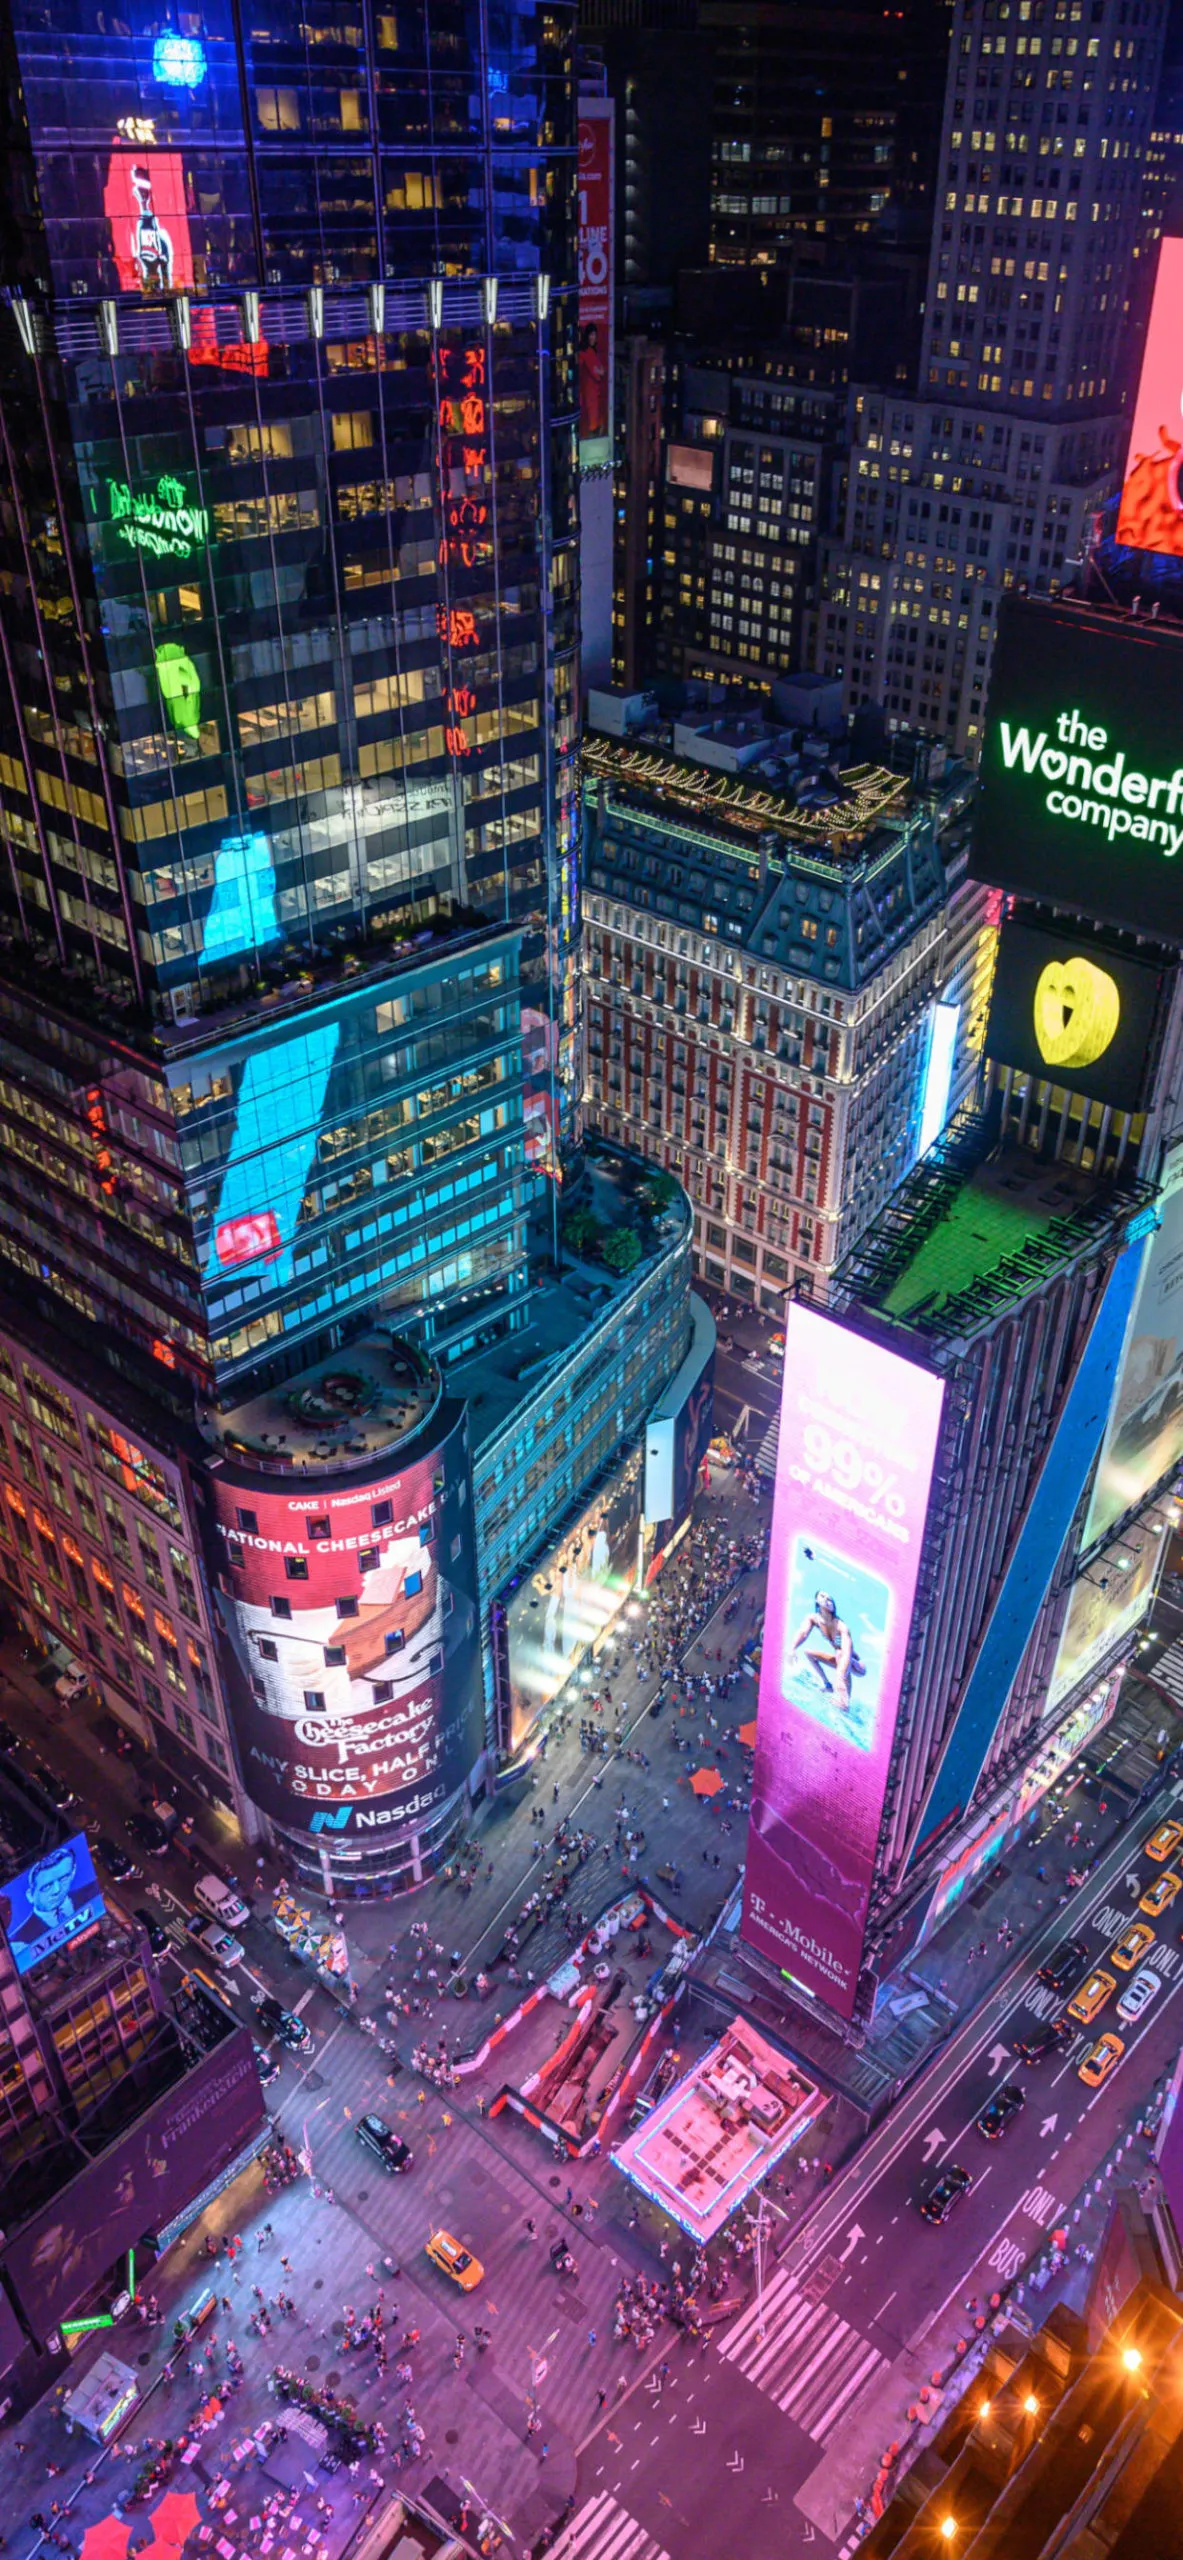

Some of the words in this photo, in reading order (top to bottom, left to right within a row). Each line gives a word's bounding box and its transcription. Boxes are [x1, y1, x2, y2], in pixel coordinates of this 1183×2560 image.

[1056, 708, 1108, 751] the
[1000, 721, 1183, 814] Wonderf
[1045, 790, 1183, 857] company
[803, 1423, 906, 1518] 99%
[288, 1500, 319, 1511] CAKE
[331, 1492, 372, 1508] Nasdaq
[371, 1480, 402, 1500] Listed
[812, 1478, 911, 1544] AMERICANS
[316, 1501, 437, 1554] CHEESECAKE
[294, 1697, 433, 1747] Cheesecake
[250, 1746, 288, 1773] ANY
[295, 1764, 367, 1783] SLICE,
[372, 1741, 431, 1777] HALF
[355, 1783, 447, 1829] Nasdaq
[1092, 1905, 1131, 1939] ONLY
[748, 1911, 798, 1953] AMERICA'S
[799, 1949, 848, 1990] NETWORK
[1024, 1985, 1065, 2021] ONLY
[162, 2060, 252, 2149] Frankenstein
[1022, 2186, 1068, 2230] ONLY
[988, 2237, 1026, 2280] BUS
